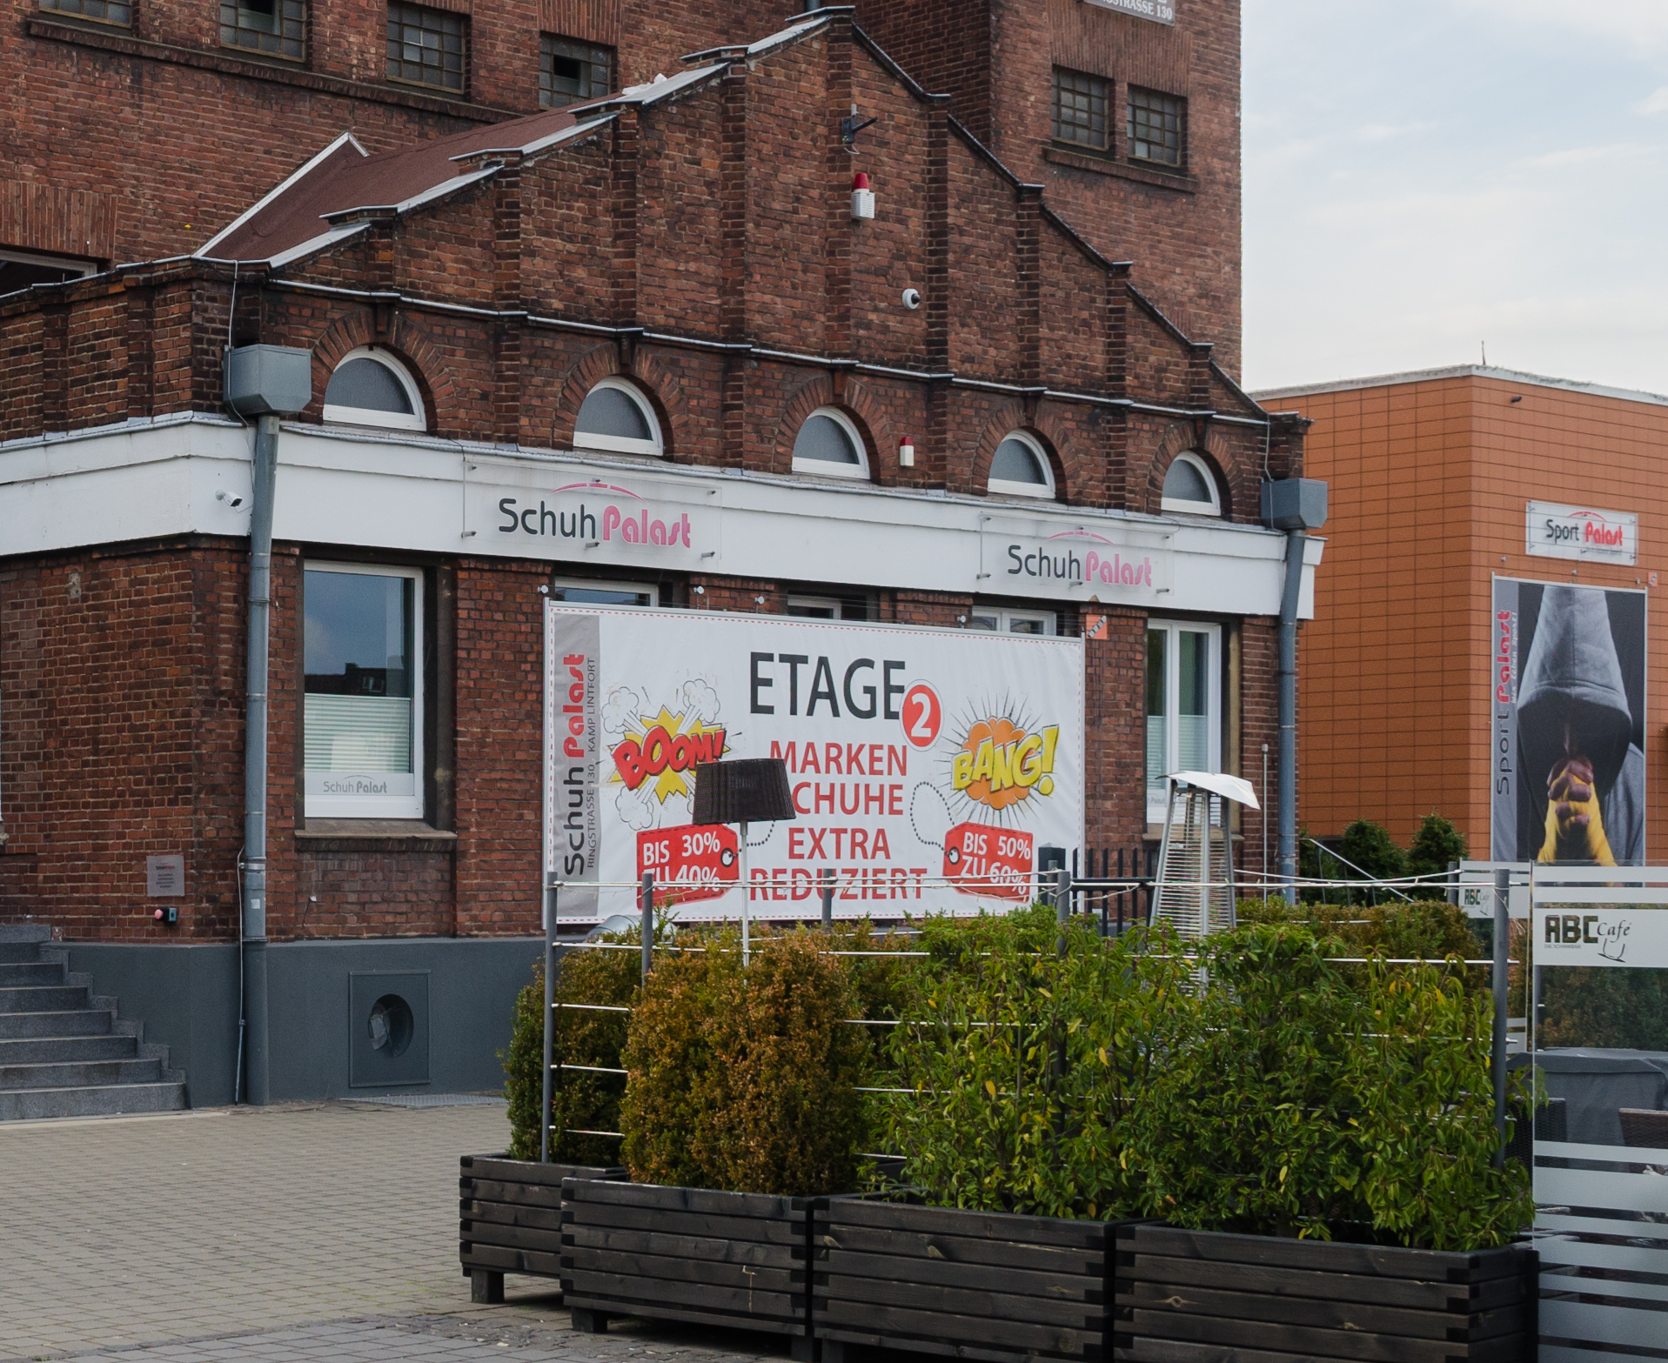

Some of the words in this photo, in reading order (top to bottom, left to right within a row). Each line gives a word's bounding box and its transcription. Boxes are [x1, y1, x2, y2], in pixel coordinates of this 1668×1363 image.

[1156, 4, 1172, 20] 130
[498, 498, 596, 540] Schuh
[602, 505, 691, 549] Palast
[1546, 519, 1579, 545] Sport
[1585, 521, 1623, 546] Palast
[1007, 544, 1081, 580] Schuh
[1085, 550, 1152, 587] Palast
[1496, 610, 1511, 704] Palast
[587, 657, 596, 714] LINTFORT
[750, 651, 906, 720] ETAGE
[910, 692, 932, 737] 2
[562, 654, 585, 758] Palast
[588, 718, 596, 752] KAMP
[1497, 710, 1512, 795] Sport
[587, 764, 595, 784] 130
[611, 725, 726, 791] BOOM!
[770, 740, 907, 776] MARKEN
[952, 724, 1059, 796] BANG!
[323, 781, 354, 793] Schuh
[356, 781, 387, 793] Palast
[791, 781, 904, 816] CHUHE
[563, 767, 585, 875] Schuh
[586, 788, 596, 868] RINGSTRASSE
[643, 840, 670, 866] BIS
[681, 831, 721, 857] 30%
[788, 827, 891, 860] EXTRA
[963, 831, 988, 855] BIS
[997, 836, 1031, 860] 50%
[643, 865, 670, 891] U
[675, 864, 720, 892] 40%
[960, 855, 986, 878] ZU
[989, 862, 1027, 895] 60%
[1545, 914, 1598, 943] ABC
[1597, 919, 1632, 943] Café
